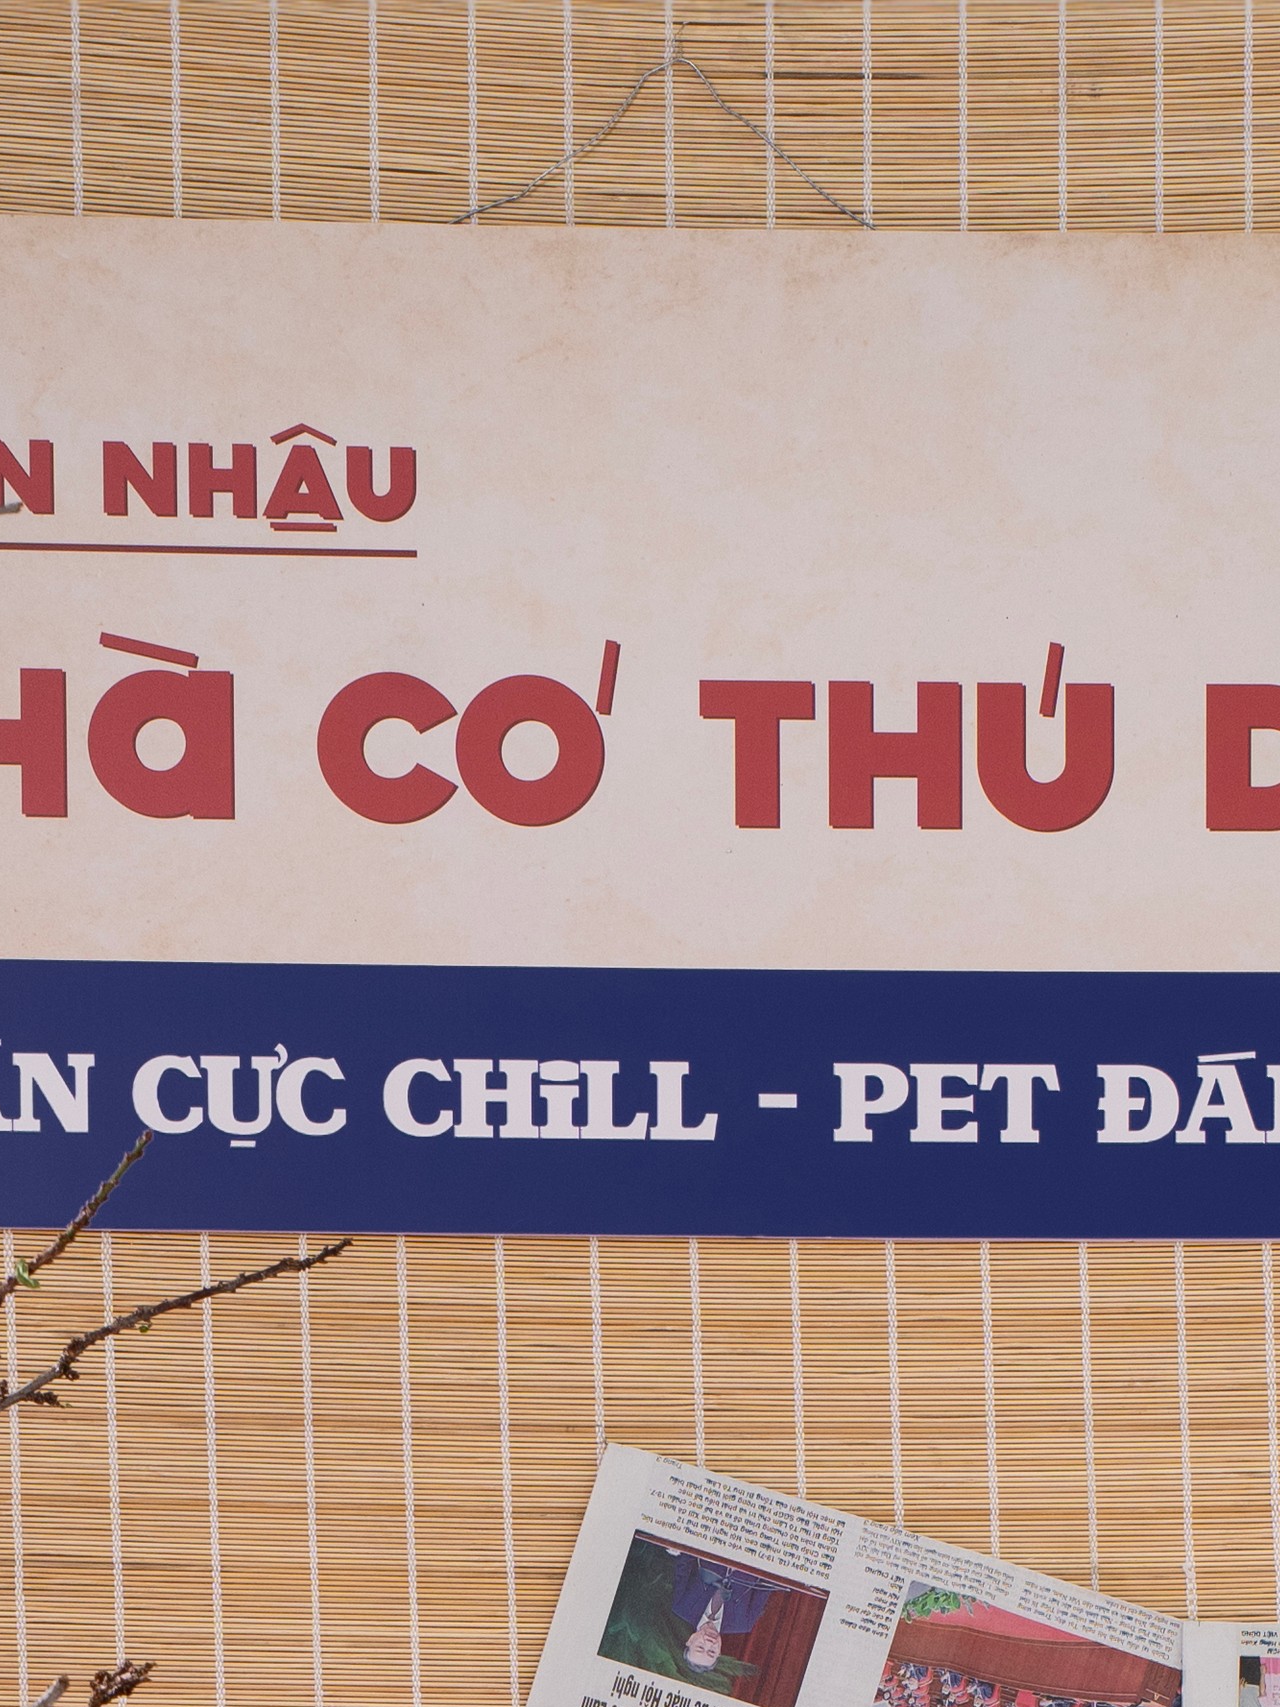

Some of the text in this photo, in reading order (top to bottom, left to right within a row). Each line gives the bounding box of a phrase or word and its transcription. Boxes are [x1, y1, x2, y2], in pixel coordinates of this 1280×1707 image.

[103, 423, 418, 532] NHẬU
[133, 1044, 346, 1147] CỰC
[834, 1063, 1060, 1143] PET
